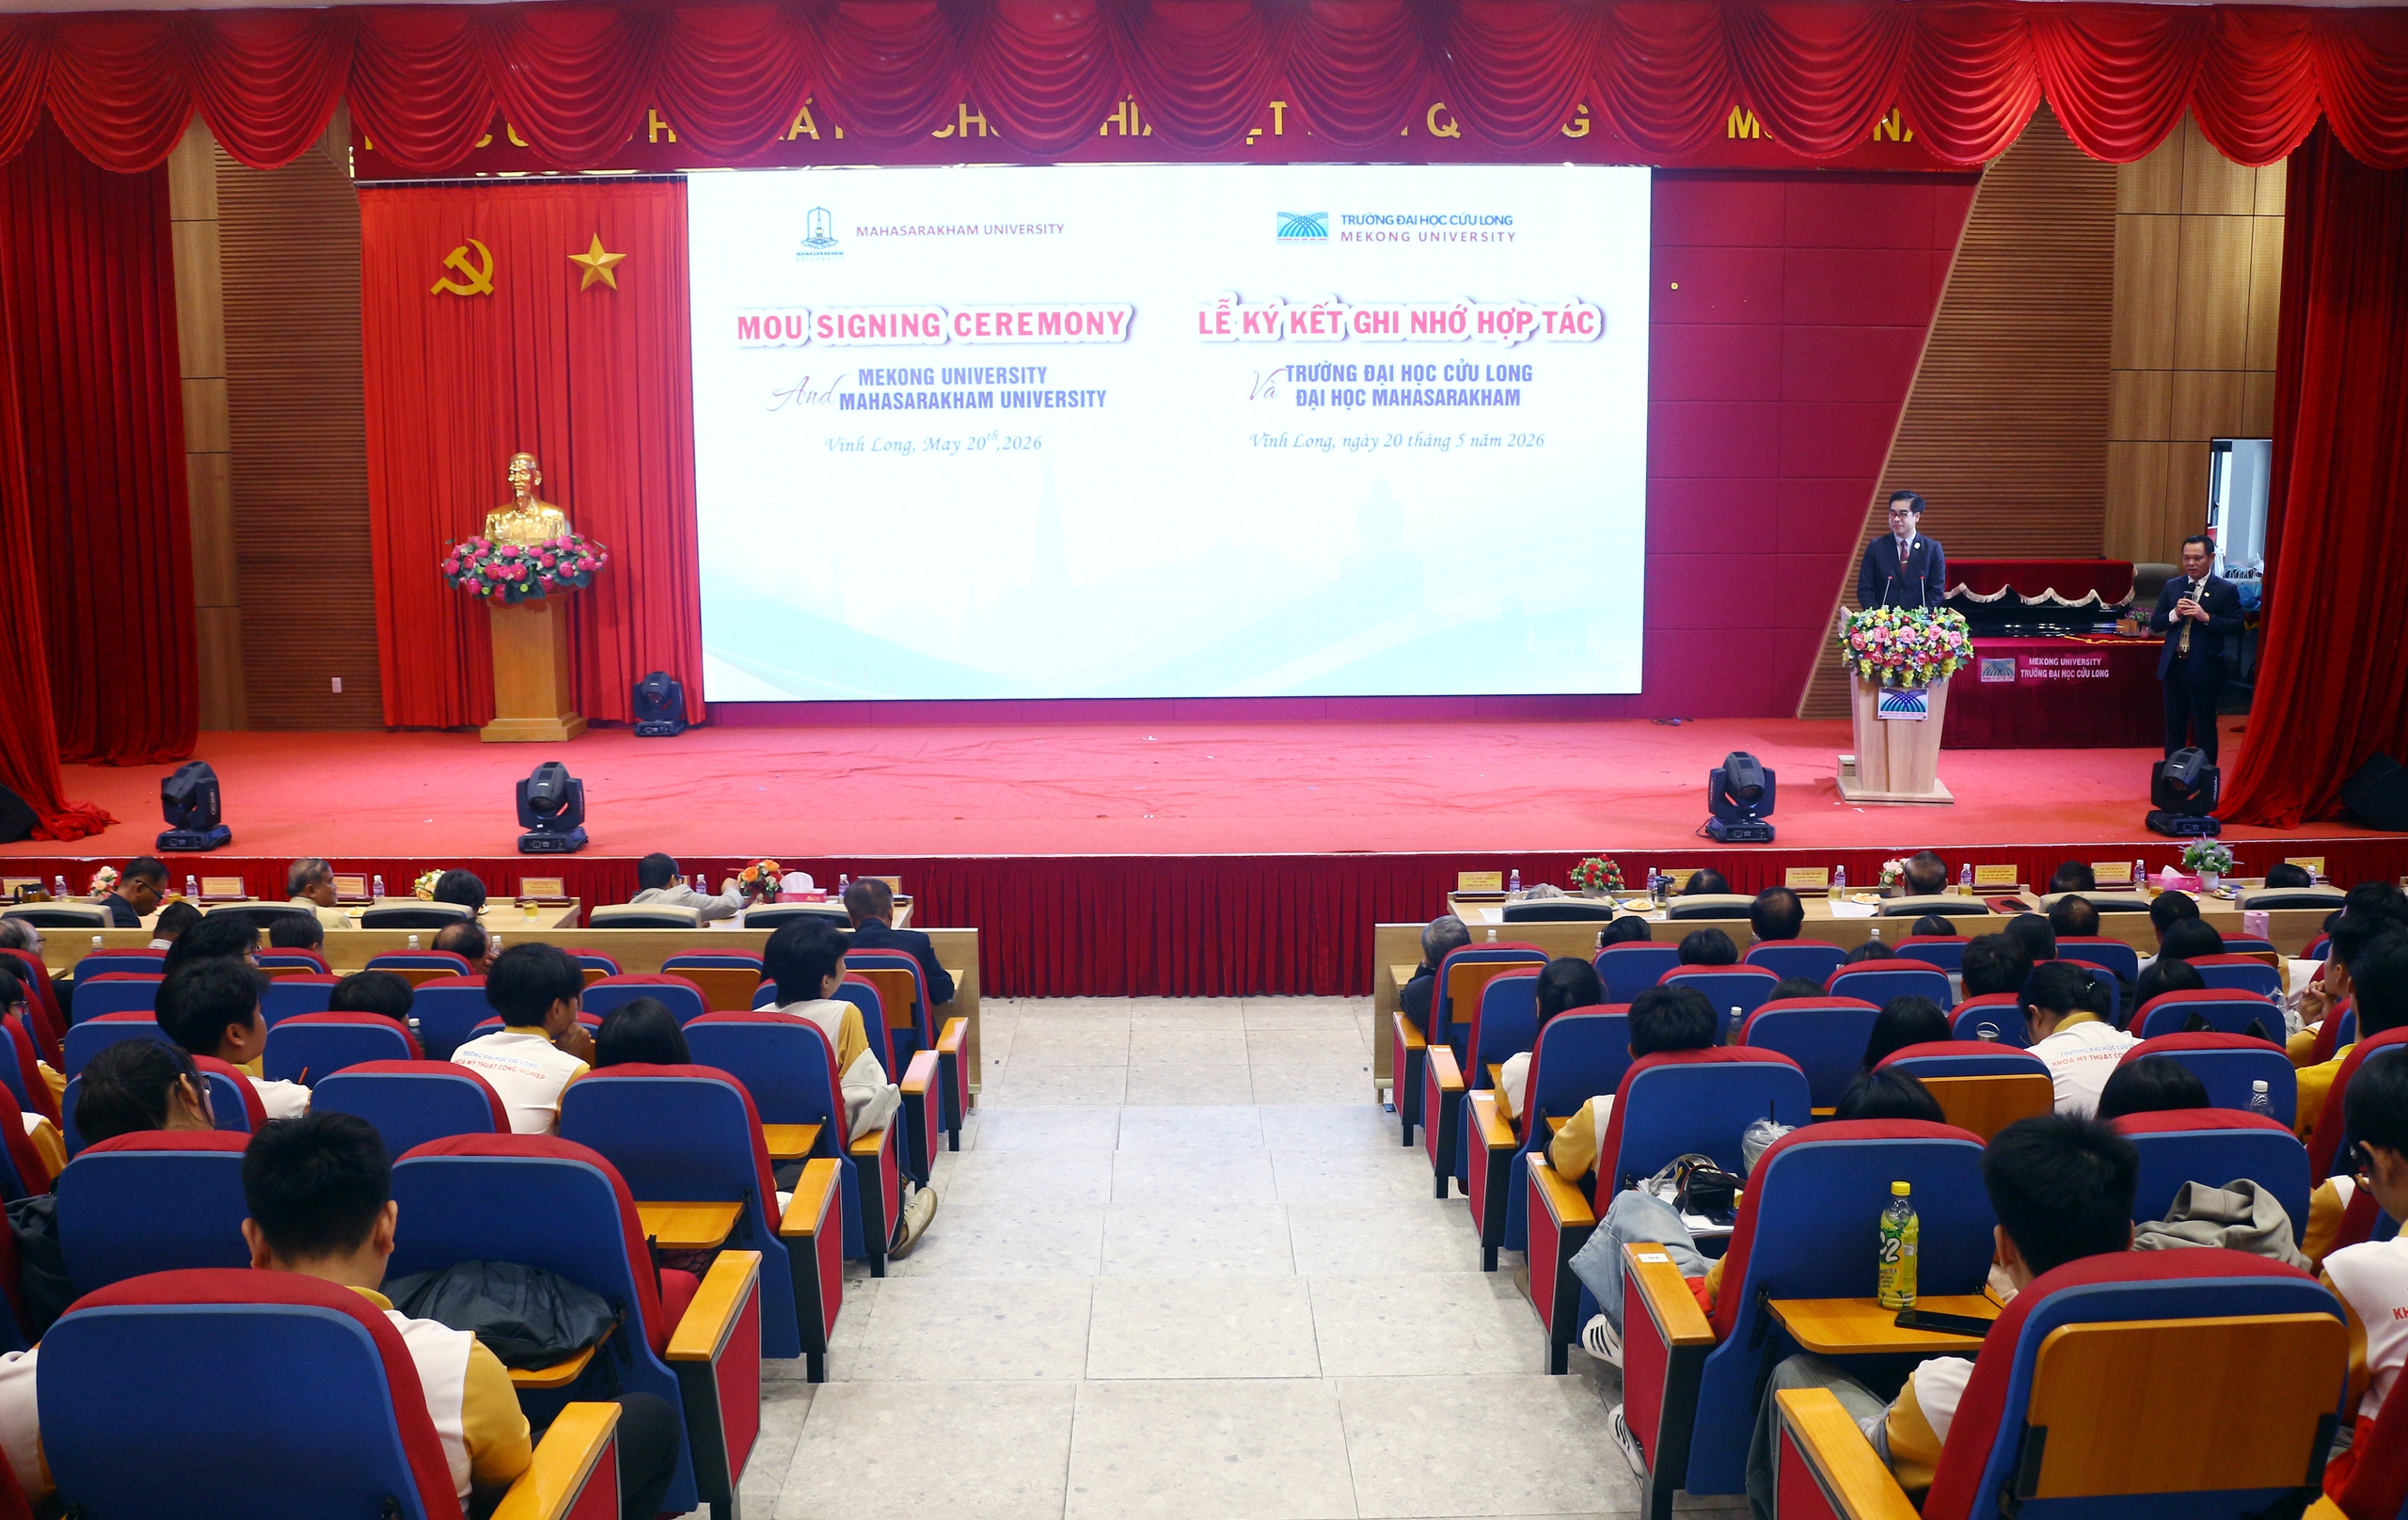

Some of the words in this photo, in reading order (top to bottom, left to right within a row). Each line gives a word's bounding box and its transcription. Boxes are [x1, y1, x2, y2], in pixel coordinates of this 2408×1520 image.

[856, 224, 978, 237] MAHASARAKHAM
[983, 223, 1065, 235] UNIVERSITY
[1340, 212, 1394, 226] TRƯỜNG
[1395, 214, 1418, 228] ĐẠI
[1419, 214, 1449, 228] HỌC
[1480, 214, 1513, 226] LONG
[1340, 231, 1411, 243] MEKONG
[1418, 231, 1516, 243] UNIVERSITY
[737, 315, 802, 340] MOU
[816, 312, 941, 339] SIGNING
[954, 310, 1125, 337] CEREMONY
[1198, 298, 1231, 335] LỄ
[1243, 304, 1279, 334] KÝ
[1291, 301, 1342, 334] KẾT
[1354, 310, 1399, 334] GHI
[1411, 303, 1469, 334] NHỚ
[1478, 309, 1533, 340] HỢP
[1542, 303, 1594, 334] TÁC
[859, 368, 935, 387] MEKONG
[942, 366, 1048, 385] UNIVERSITY
[1286, 360, 1357, 383] TRƯỜNG
[1364, 364, 1396, 386] ĐẠI
[1401, 364, 1436, 386] HỌC
[1444, 358, 1480, 382] CỬU
[1486, 364, 1533, 383] LONG
[766, 372, 851, 412] And
[1249, 368, 1287, 401] Và
[839, 391, 993, 411] MAHASARAKHAM
[1000, 389, 1106, 408] UNIVERSITY
[1296, 388, 1324, 410] ĐẠI
[1331, 388, 1366, 410] HỌC
[1372, 388, 1521, 407] MAHASARAKHAM
[824, 436, 865, 452] Vinh
[870, 436, 916, 456] Long,
[922, 436, 961, 456] May
[1249, 432, 1288, 449] Vĩnh
[1292, 433, 1338, 451] Long,
[1342, 433, 1379, 452] ngày
[1384, 433, 1403, 448] 20
[1408, 433, 1450, 451] tháng
[1456, 433, 1465, 448] 5
[1471, 433, 1503, 448] năm
[1508, 433, 1545, 448] 2026
[2052, 1057, 2074, 1067] KHOA
[2393, 1307, 2408, 1320] KH
